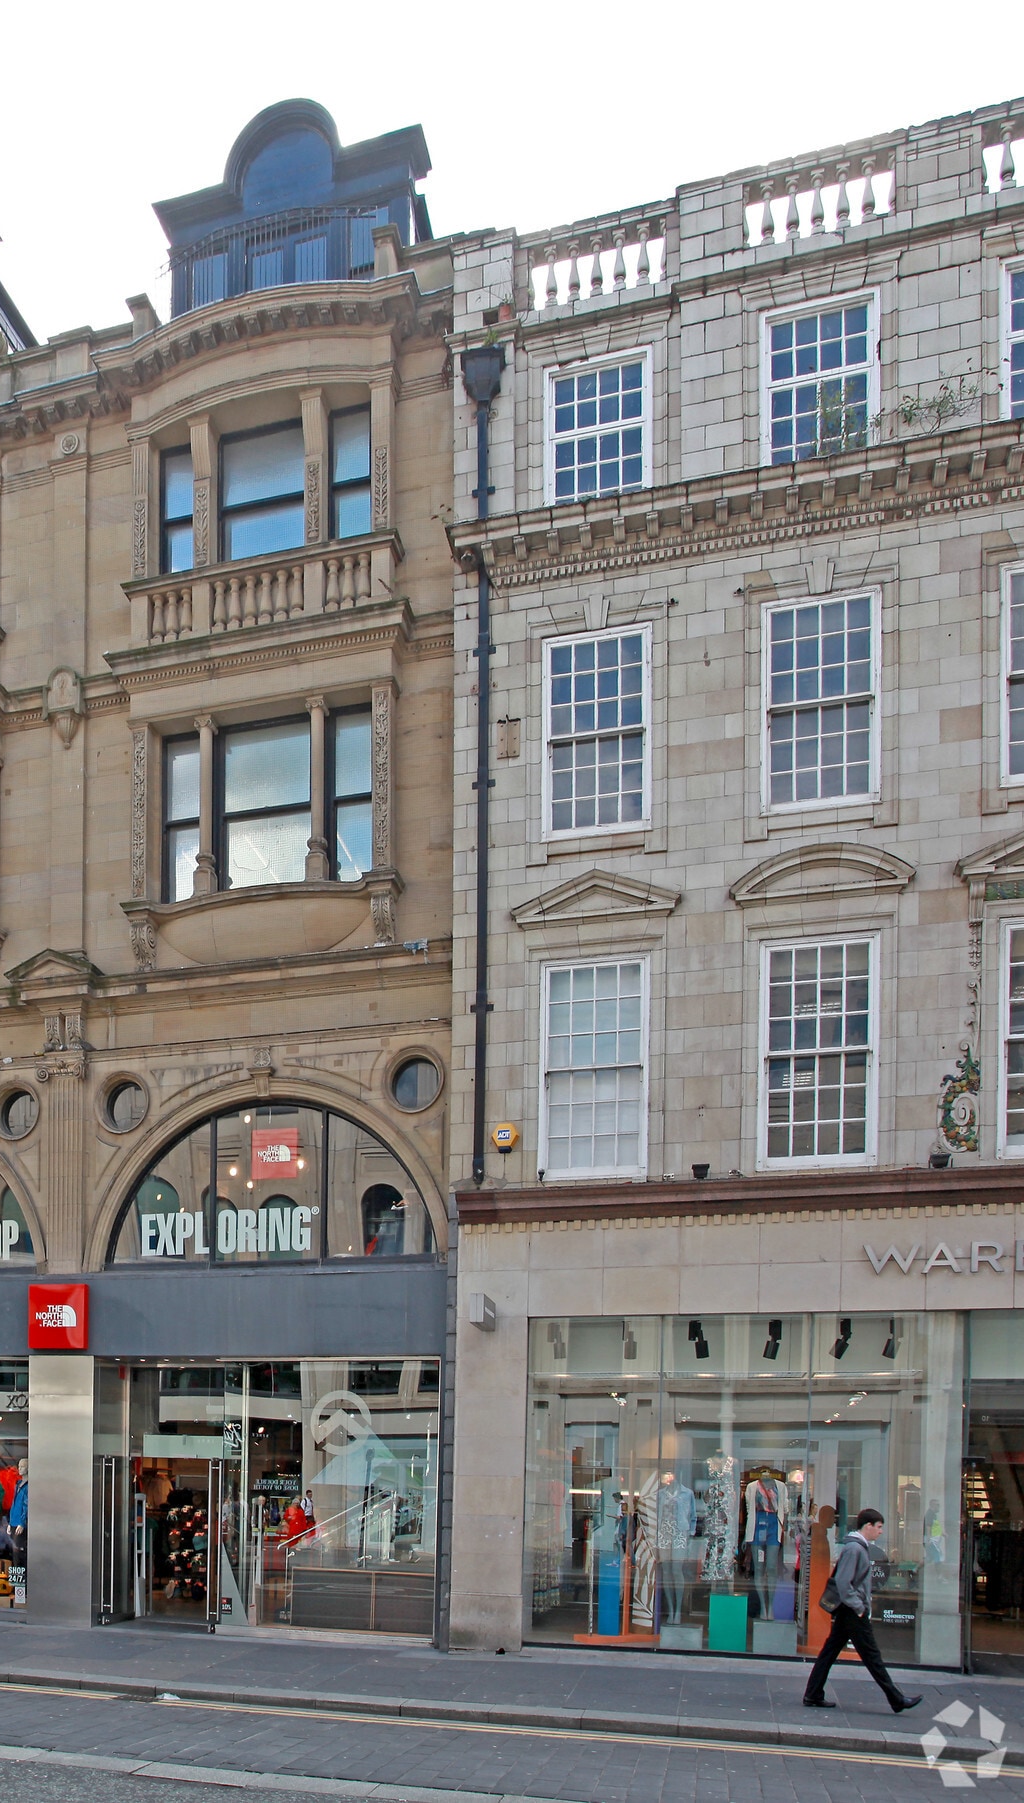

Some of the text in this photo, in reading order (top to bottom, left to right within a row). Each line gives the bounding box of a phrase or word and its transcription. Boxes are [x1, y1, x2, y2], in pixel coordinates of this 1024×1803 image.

[35, 1312, 62, 1320] NORTH
[43, 1319, 62, 1327] FACE
[8, 1566, 26, 1574] SHOP
